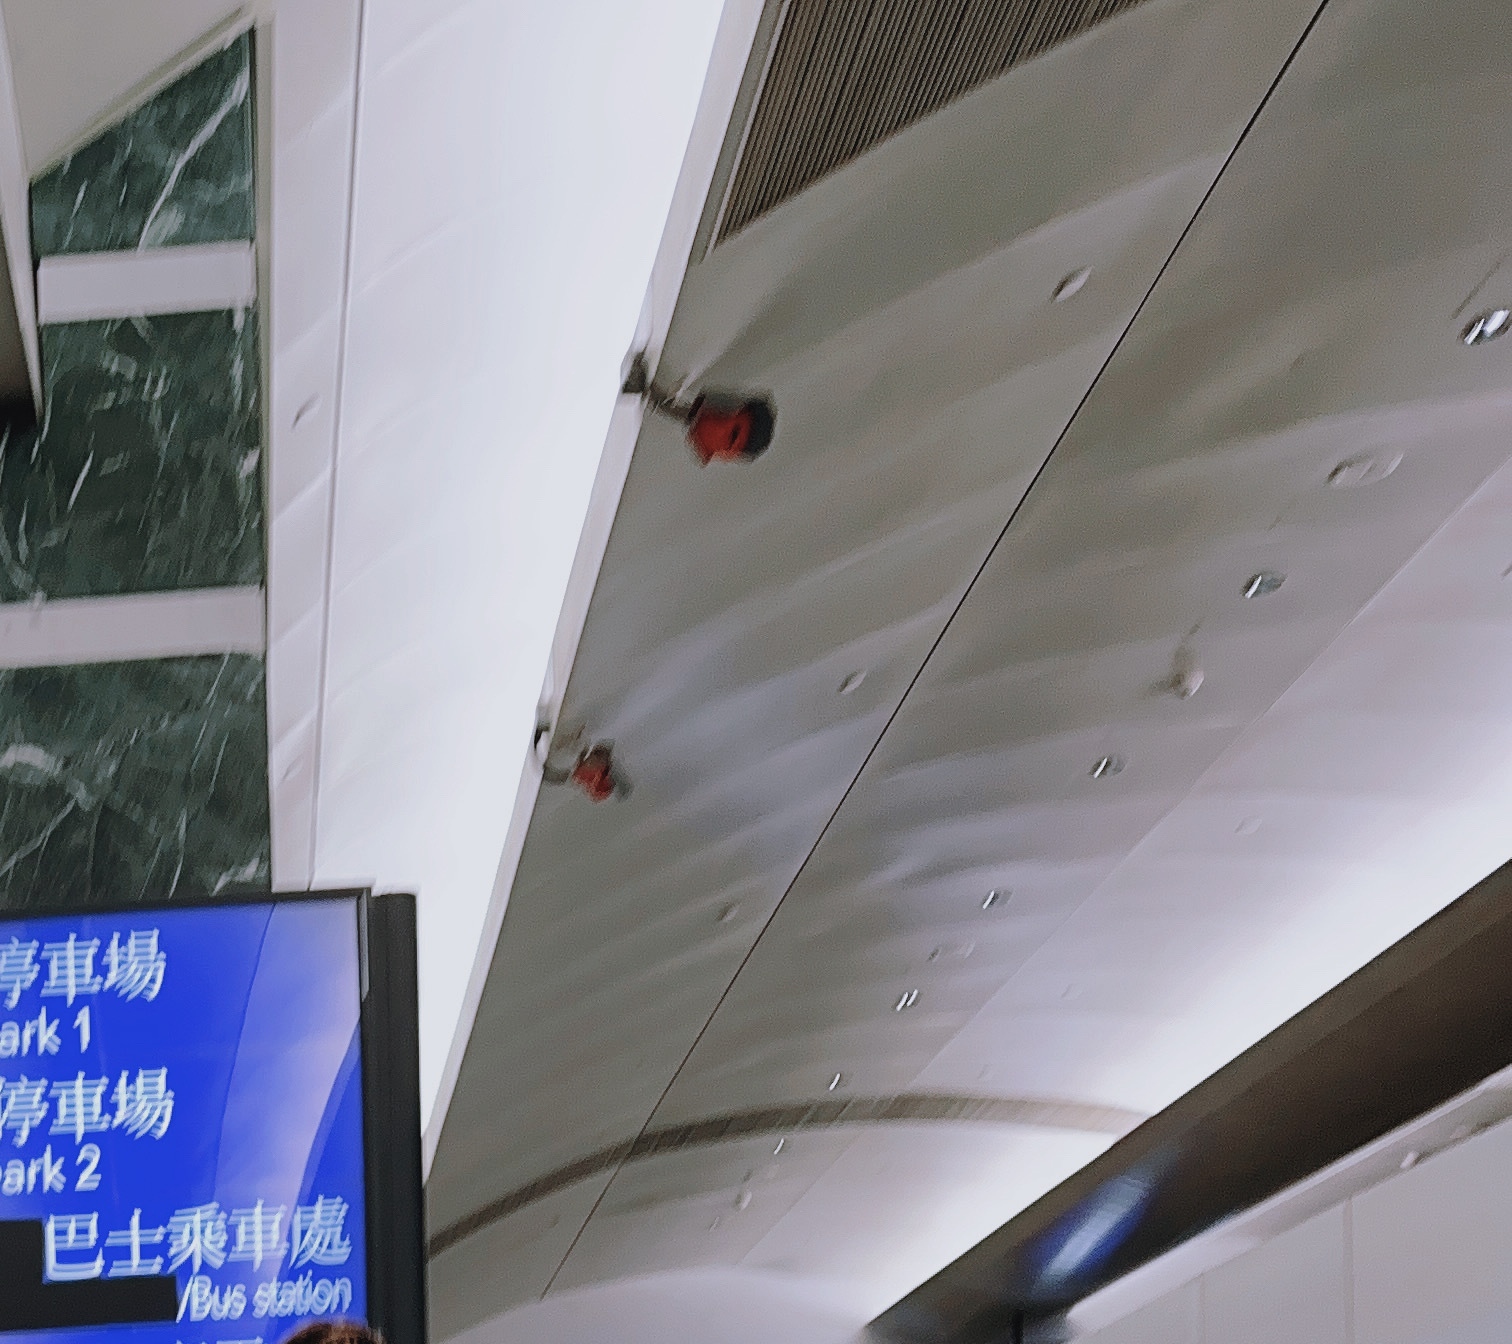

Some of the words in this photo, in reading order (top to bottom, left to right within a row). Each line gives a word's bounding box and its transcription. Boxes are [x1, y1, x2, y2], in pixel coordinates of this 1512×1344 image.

[73, 1005, 90, 1053] 1
[75, 1143, 101, 1192] 2
[43, 1194, 352, 1283] 巴士乘車處
[253, 1269, 352, 1319] station
